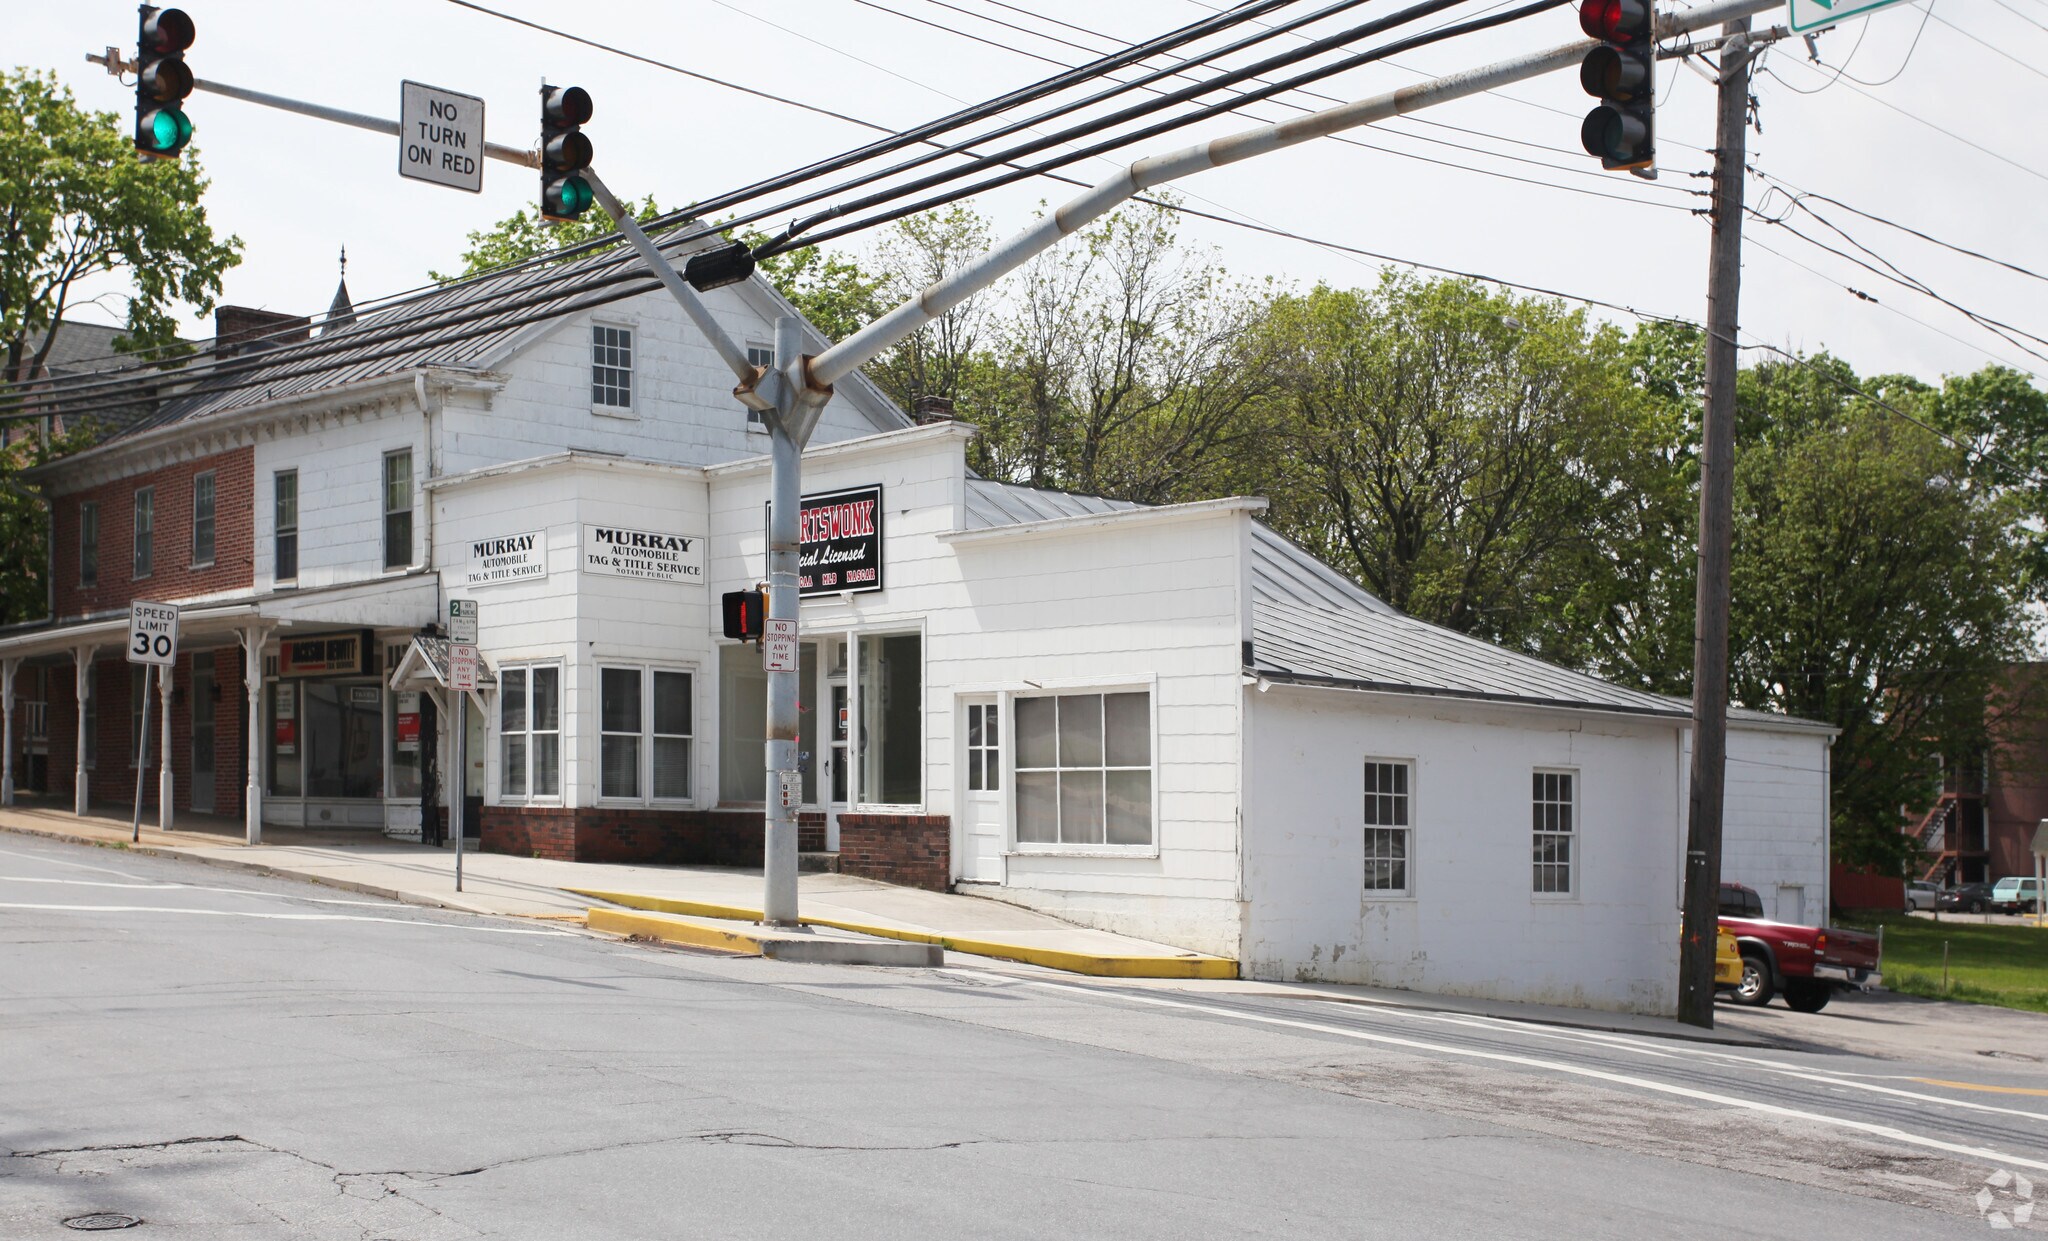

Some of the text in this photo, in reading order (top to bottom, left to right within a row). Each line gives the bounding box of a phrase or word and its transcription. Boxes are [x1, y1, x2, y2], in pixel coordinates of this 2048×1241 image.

[430, 100, 457, 121] NO
[419, 122, 466, 149] TURN
[408, 145, 474, 175] ON RED
[800, 500, 874, 544] RTSWONK
[474, 535, 536, 558] MURRAY
[595, 528, 693, 552] MURRAY
[482, 554, 528, 568] AUTOMOBILE
[611, 546, 678, 562] AUTOMOBILE
[800, 543, 866, 567] cial Licensed
[468, 564, 543, 583] TAG & TITLE SERVICE
[588, 554, 701, 576] TAG & TITLE SERVICE
[616, 568, 674, 580] NOTARY PUBLIC
[799, 568, 875, 588] CAA MLB NASCAR
[135, 607, 174, 620] SPEED
[452, 603, 459, 614] 2
[138, 621, 169, 632] LIMIT
[775, 623, 787, 631] NO
[133, 632, 172, 657] 30
[767, 633, 796, 642] STOPPING
[451, 657, 476, 665] STOPPING
[772, 652, 789, 660] TIME
